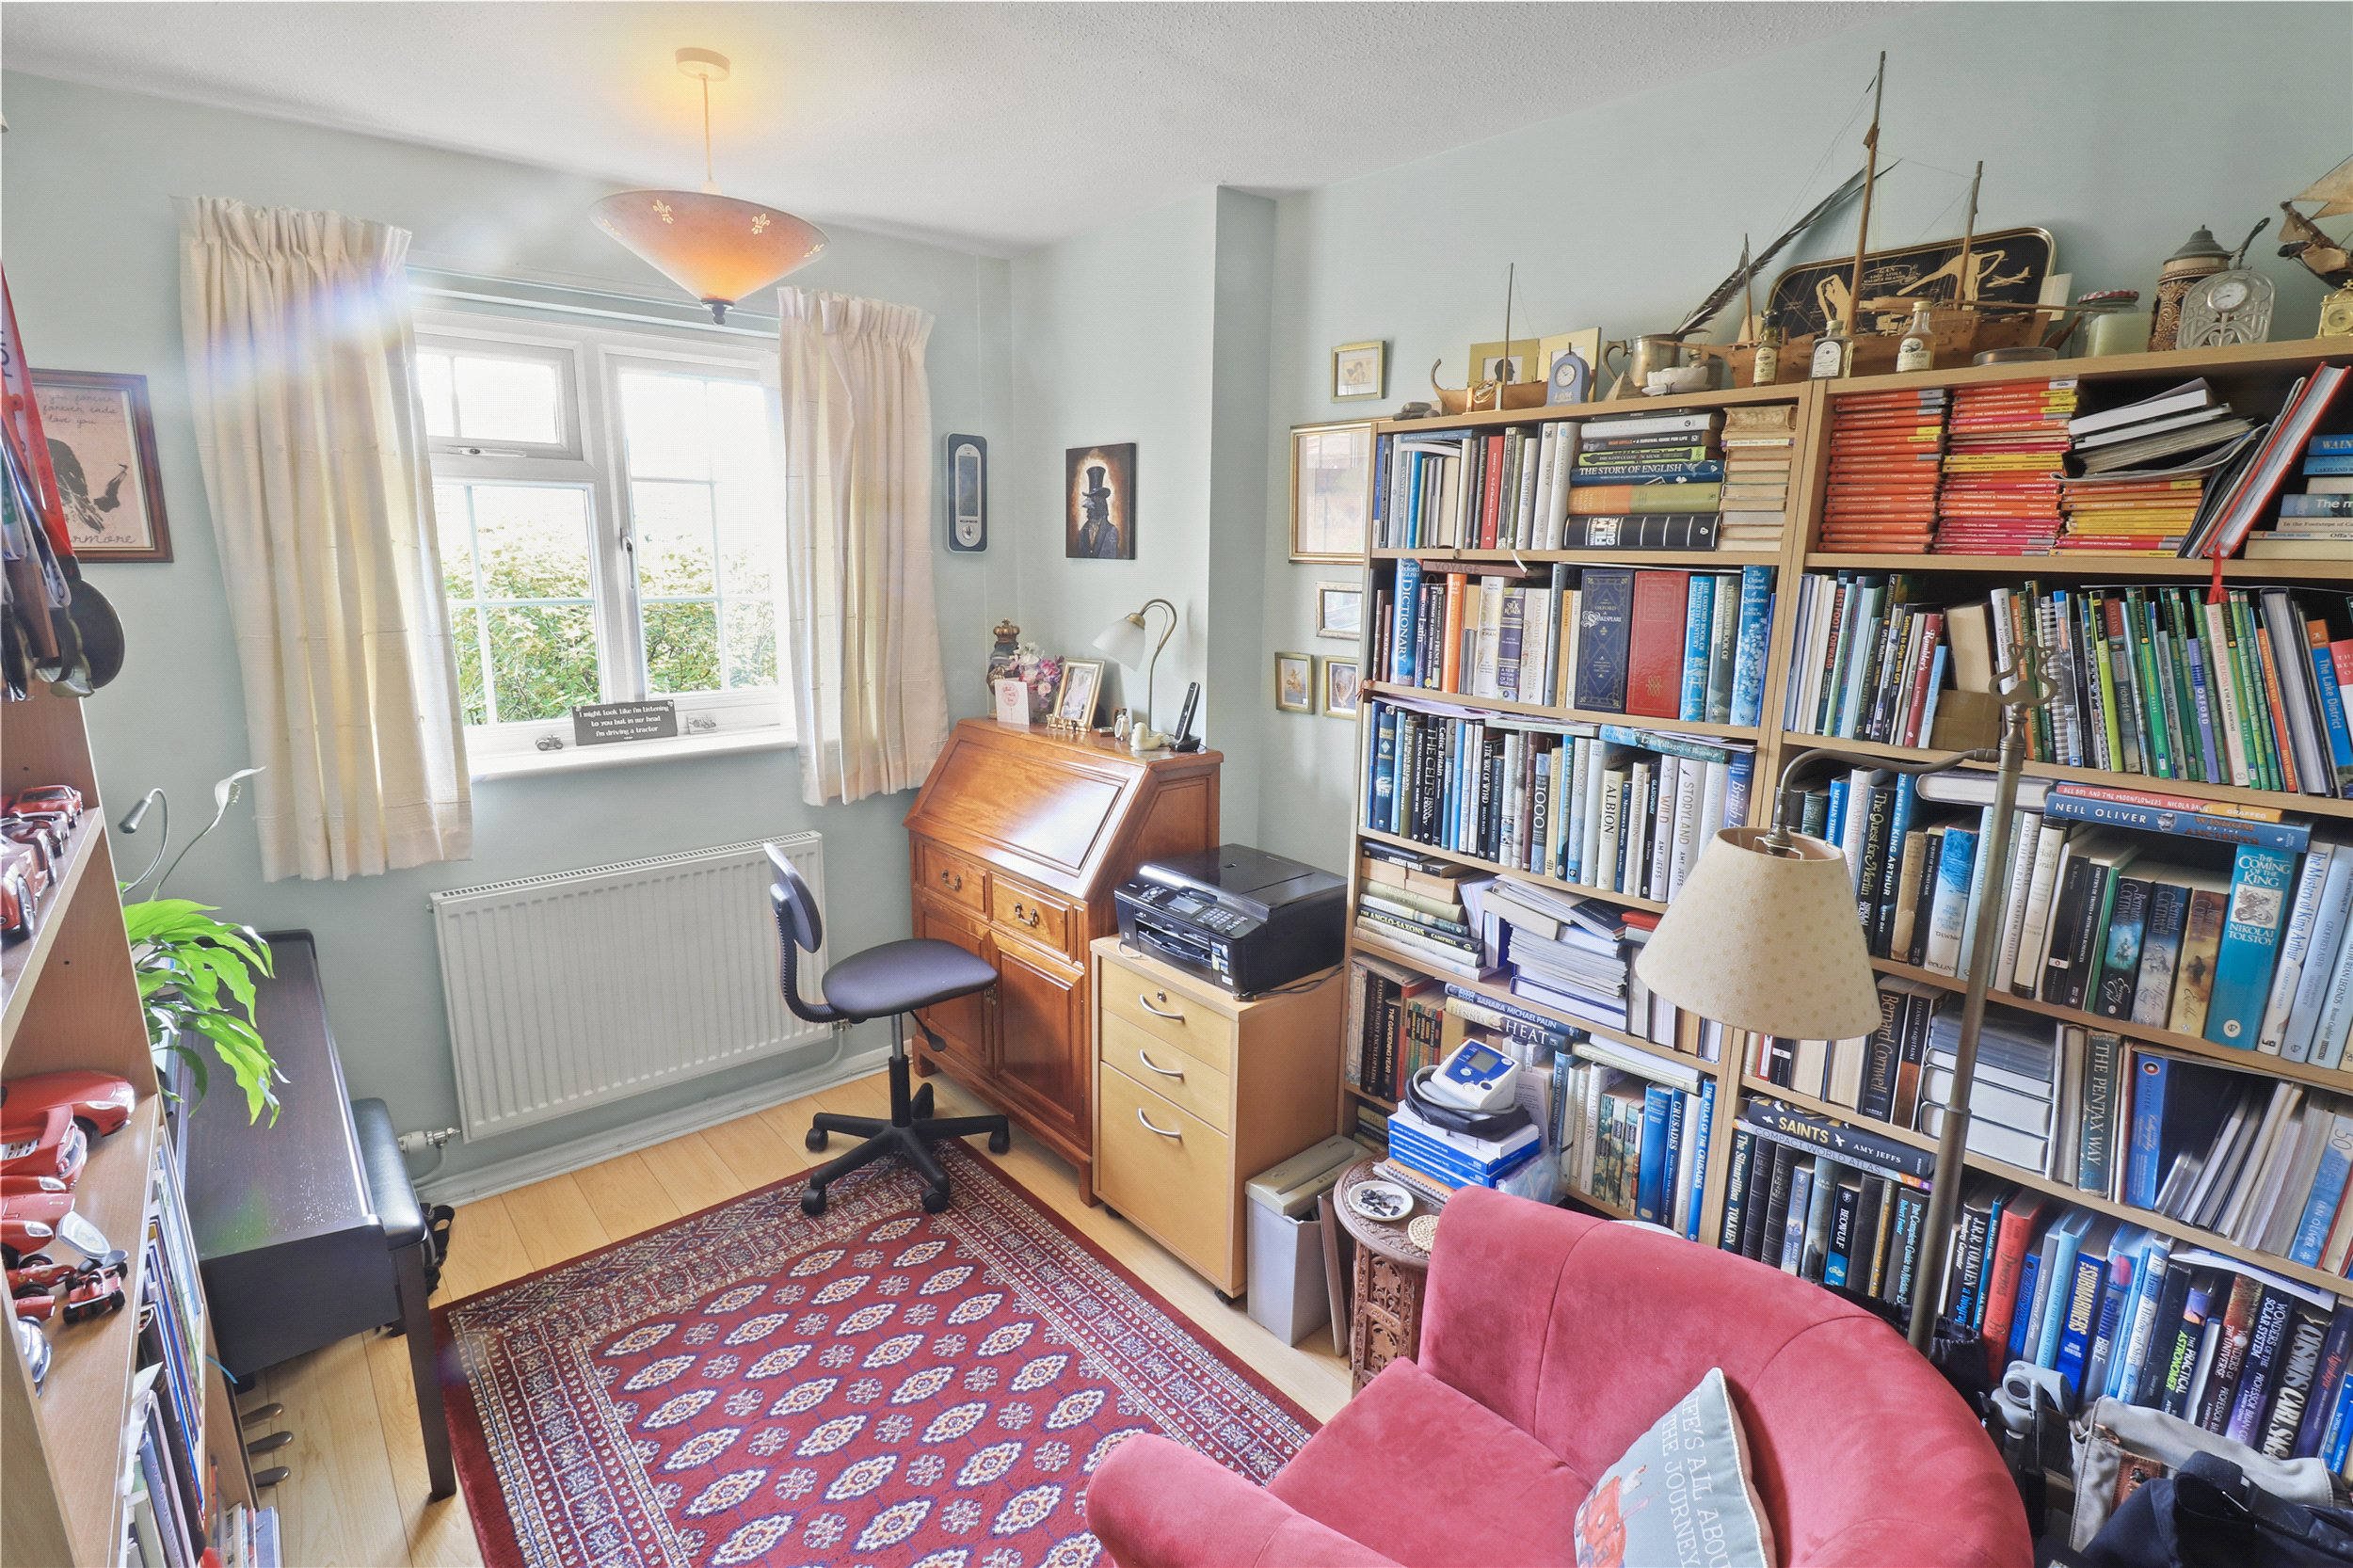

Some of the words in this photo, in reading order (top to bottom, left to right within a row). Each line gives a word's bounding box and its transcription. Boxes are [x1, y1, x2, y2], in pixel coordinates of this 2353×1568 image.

[1579, 467, 1596, 475] THE
[1598, 466, 1625, 474] STORY
[1628, 465, 1640, 473] OF
[1641, 464, 1682, 472] ENGLISH
[2316, 499, 2340, 508] The
[1594, 518, 1609, 546] FILM
[1606, 518, 1619, 546] GUIDE
[1435, 564, 1481, 573] VOYAGE
[1833, 588, 1844, 607] BEST
[1398, 578, 1413, 663] DICTIONARY
[1831, 608, 1841, 631] FOOT
[1721, 630, 1730, 649] BOOK
[1825, 632, 1837, 670] FORWARD
[1721, 651, 1728, 660] OF
[2320, 658, 2331, 675] The
[2323, 677, 2335, 696] Lake
[2199, 688, 2209, 725] OXFORD
[2327, 697, 2341, 730] District
[606, 728, 629, 737] driving
[614, 717, 627, 726] but
[1427, 727, 1438, 754] THE
[1425, 756, 1435, 795] CELTS
[1532, 786, 1547, 829] 1000
[1604, 785, 1616, 834] ALBION
[1658, 795, 1672, 824] WILD
[1678, 782, 1695, 845] STORYLAND
[1728, 781, 1746, 819] British
[1832, 789, 1841, 818] MERLIN
[1875, 793, 1888, 814] The
[2055, 802, 2086, 814] NEIL
[2095, 809, 2147, 824] OLIVER
[2167, 800, 2189, 810] NICOLA
[1657, 840, 1665, 856] AMY
[1889, 828, 1901, 853] KING
[1655, 858, 1663, 879] JEFFS
[1678, 851, 1687, 866] AMY
[2238, 856, 2290, 875] COMING
[2258, 854, 2273, 862] THE
[1676, 868, 1685, 887] JEFFS
[1883, 856, 1897, 896] ARTHUR
[2243, 872, 2280, 888] KING
[1369, 911, 1425, 936] ANGLO-SAXONS
[1431, 933, 1457, 946] CAMPBELL
[2227, 931, 2274, 946] TOLSTOY
[2229, 923, 2275, 938] NIKOLAI
[1476, 996, 1505, 1011] SAHARA
[1507, 1006, 1535, 1022] MICHAEL
[1535, 1016, 1557, 1030] PALIN
[1881, 994, 1899, 1046] Bernard
[1506, 1020, 1549, 1045] HEAT
[1873, 1047, 1893, 1094] Cornwell
[2096, 1044, 2109, 1074] THE
[1702, 1101, 1711, 1122] ATLAS
[2089, 1077, 2107, 1136] PENTAX
[1670, 1101, 1681, 1151] CRUSADES
[1701, 1124, 1708, 1134] OF
[1779, 1116, 1829, 1144] SAINTS
[1853, 1144, 1875, 1155] AMY
[1876, 1151, 1901, 1164] JEFFS
[2332, 1128, 2353, 1150] 50
[1699, 1135, 1707, 1147] THE
[1736, 1133, 1749, 1151] The
[1755, 1128, 1804, 1149] COMPACT
[1806, 1144, 1846, 1162] WORLD
[1849, 1159, 1881, 1175] ATLAS
[2087, 1138, 2104, 1166] WAY
[1694, 1149, 1705, 1189] CRUSADES
[1729, 1151, 1745, 1202] Silmarillion
[2314, 1201, 2327, 1216] IAN
[1724, 1206, 1739, 1246] TOLKIEN
[1835, 1208, 1849, 1249] BEOWULF
[2304, 1218, 2321, 1247] OLIVER
[1963, 1245, 1979, 1288] TOLKIEN
[2068, 1264, 2097, 1338] SUBMARINERS
[2257, 1297, 2273, 1327] SOLAR
[2266, 1303, 2285, 1346] WONDERS
[2092, 1336, 2107, 1366] BIBLE
[2250, 1325, 2266, 1359] SYSTEM
[2166, 1330, 2186, 1391] ASTRONOMER
[2176, 1348, 2196, 1395] PRACTICAL
[2215, 1336, 2232, 1380] UNIVERSE
[2283, 1321, 2319, 1395] COSMOS
[2246, 1371, 2264, 1412] PROFESSOR
[1662, 1415, 1679, 1457] THE
[1687, 1457, 1712, 1501] ALL
[1665, 1461, 1701, 1568] JOURNEY
